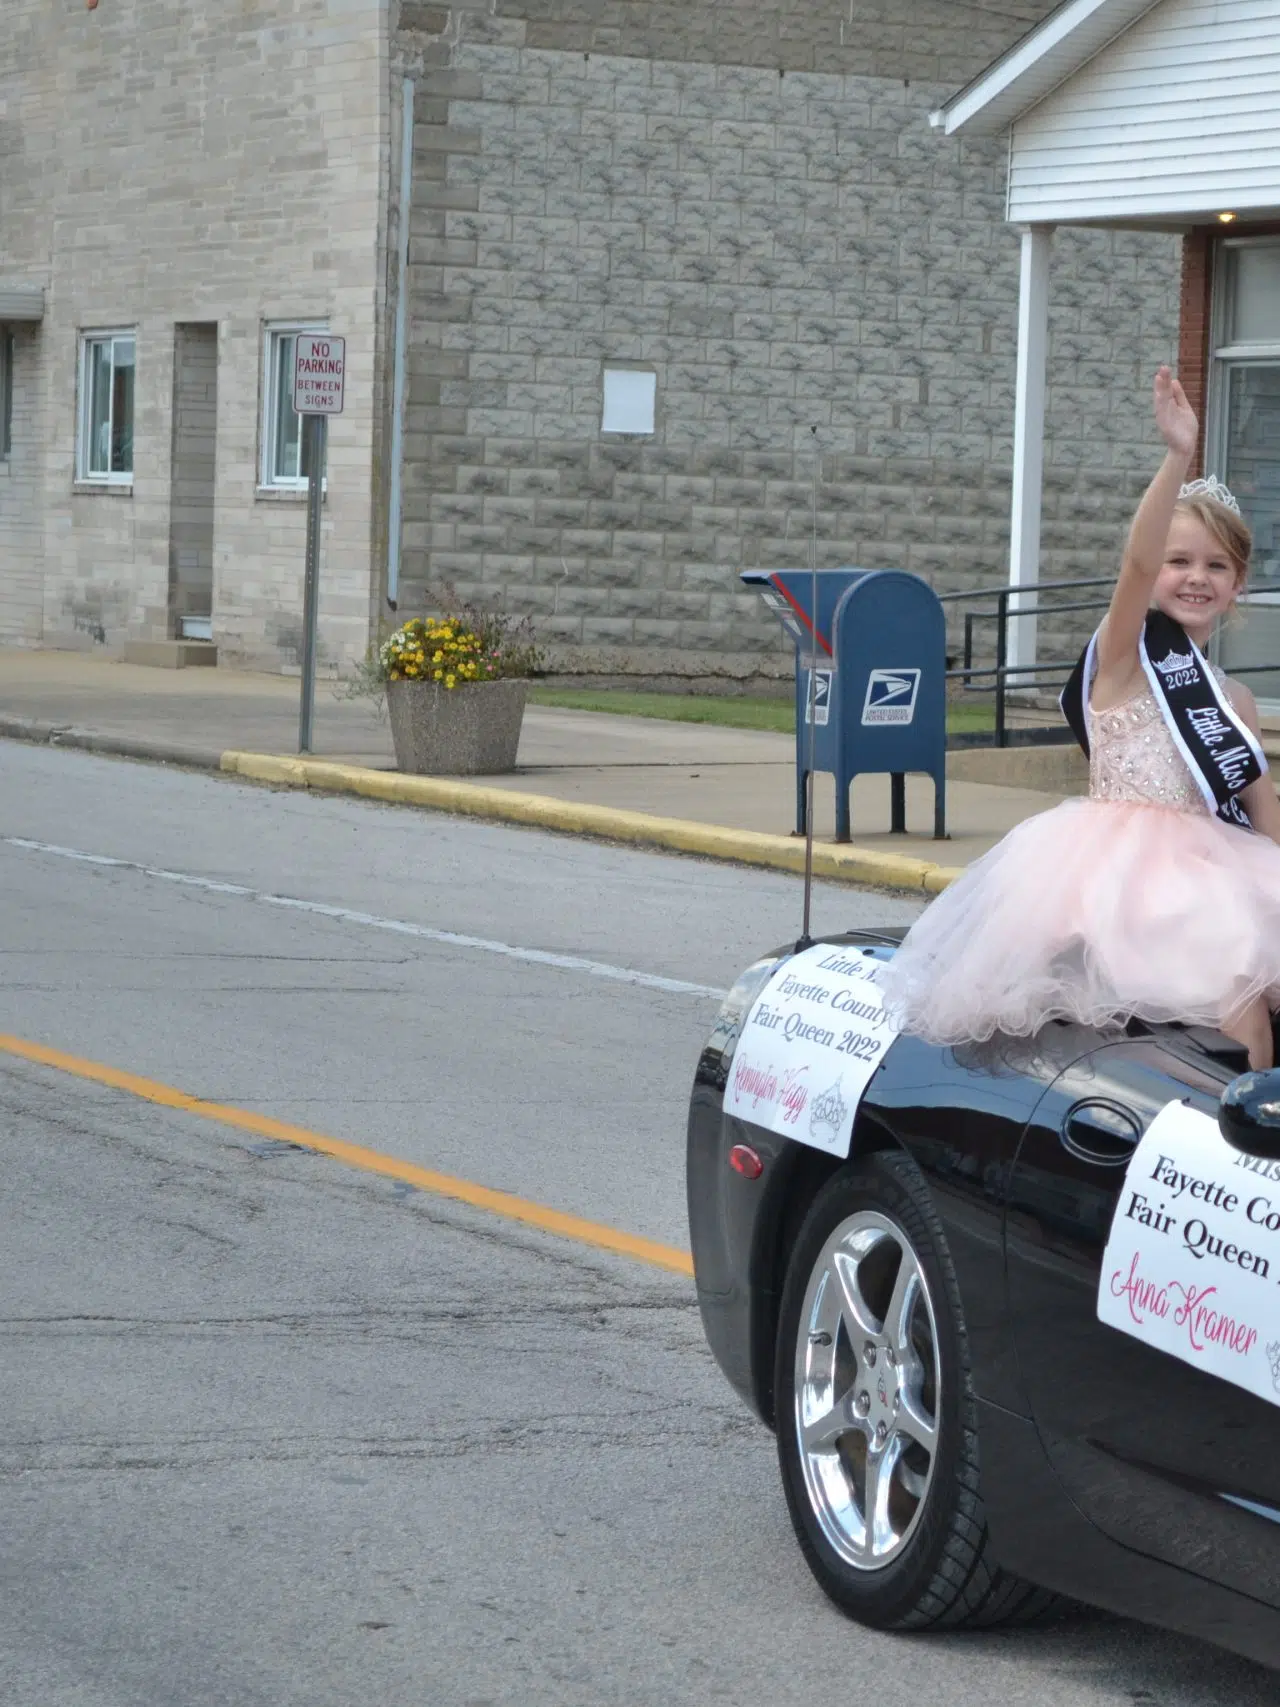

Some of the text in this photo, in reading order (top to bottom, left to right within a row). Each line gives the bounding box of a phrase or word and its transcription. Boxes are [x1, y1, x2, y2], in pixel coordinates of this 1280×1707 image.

[298, 358, 342, 375] PARKING
[311, 342, 330, 358] NO
[297, 379, 341, 392] BETWEEN
[304, 394, 334, 406] SIGNS
[1165, 668, 1200, 690] 2022
[1185, 707, 1233, 747] Little
[1210, 745, 1250, 790] Miss
[816, 954, 863, 978] Little
[776, 973, 830, 1003] Fayette
[830, 989, 892, 1031] County
[752, 1002, 882, 1063] Fair Queen 2022
[1149, 1154, 1239, 1213] Fayette
[1124, 1191, 1177, 1235] Fair
[1182, 1218, 1270, 1279] Queen
[1110, 1252, 1258, 1356] Anna Kramer
